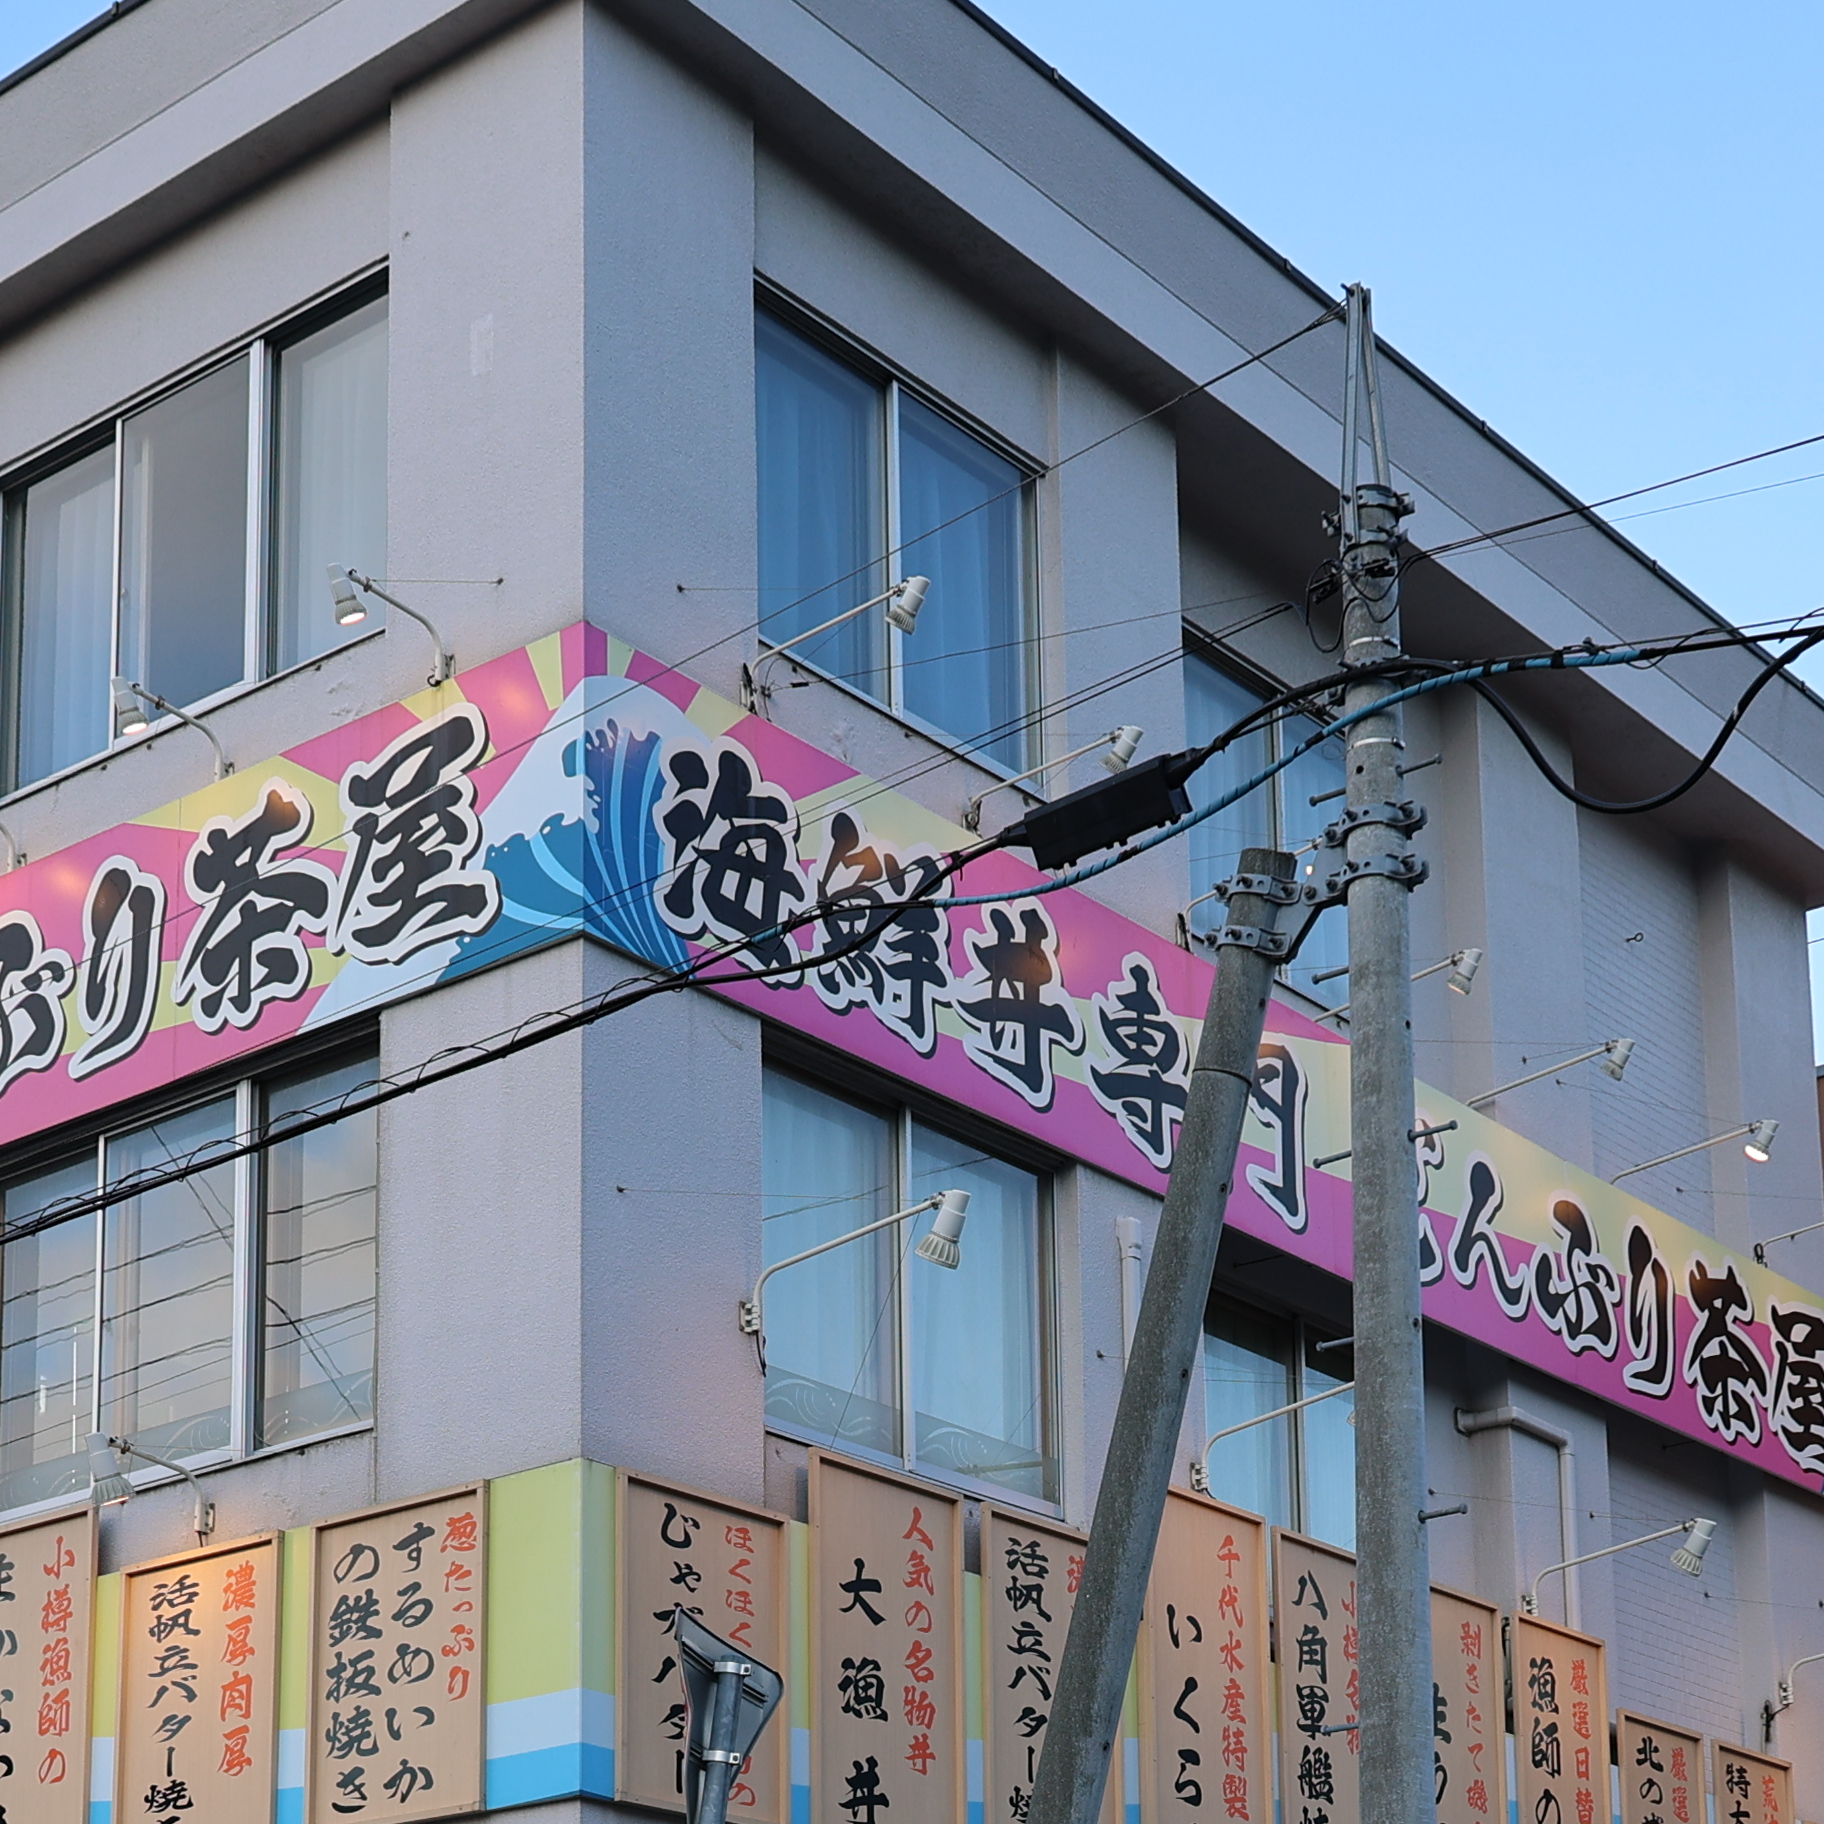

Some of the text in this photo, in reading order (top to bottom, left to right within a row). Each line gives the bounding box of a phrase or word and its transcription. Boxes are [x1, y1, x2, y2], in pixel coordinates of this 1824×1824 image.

[37, 1534, 76, 1785] 小樽漁師の
[216, 1559, 257, 1777] 濃厚肉厚
[325, 1541, 383, 1814] の鉄板焼き
[382, 1521, 437, 1805] するめいか
[440, 1510, 477, 1703] 葱たっぷり
[902, 1506, 936, 1776] 人気の名物丼
[1217, 1534, 1250, 1822] 千代水産特製
